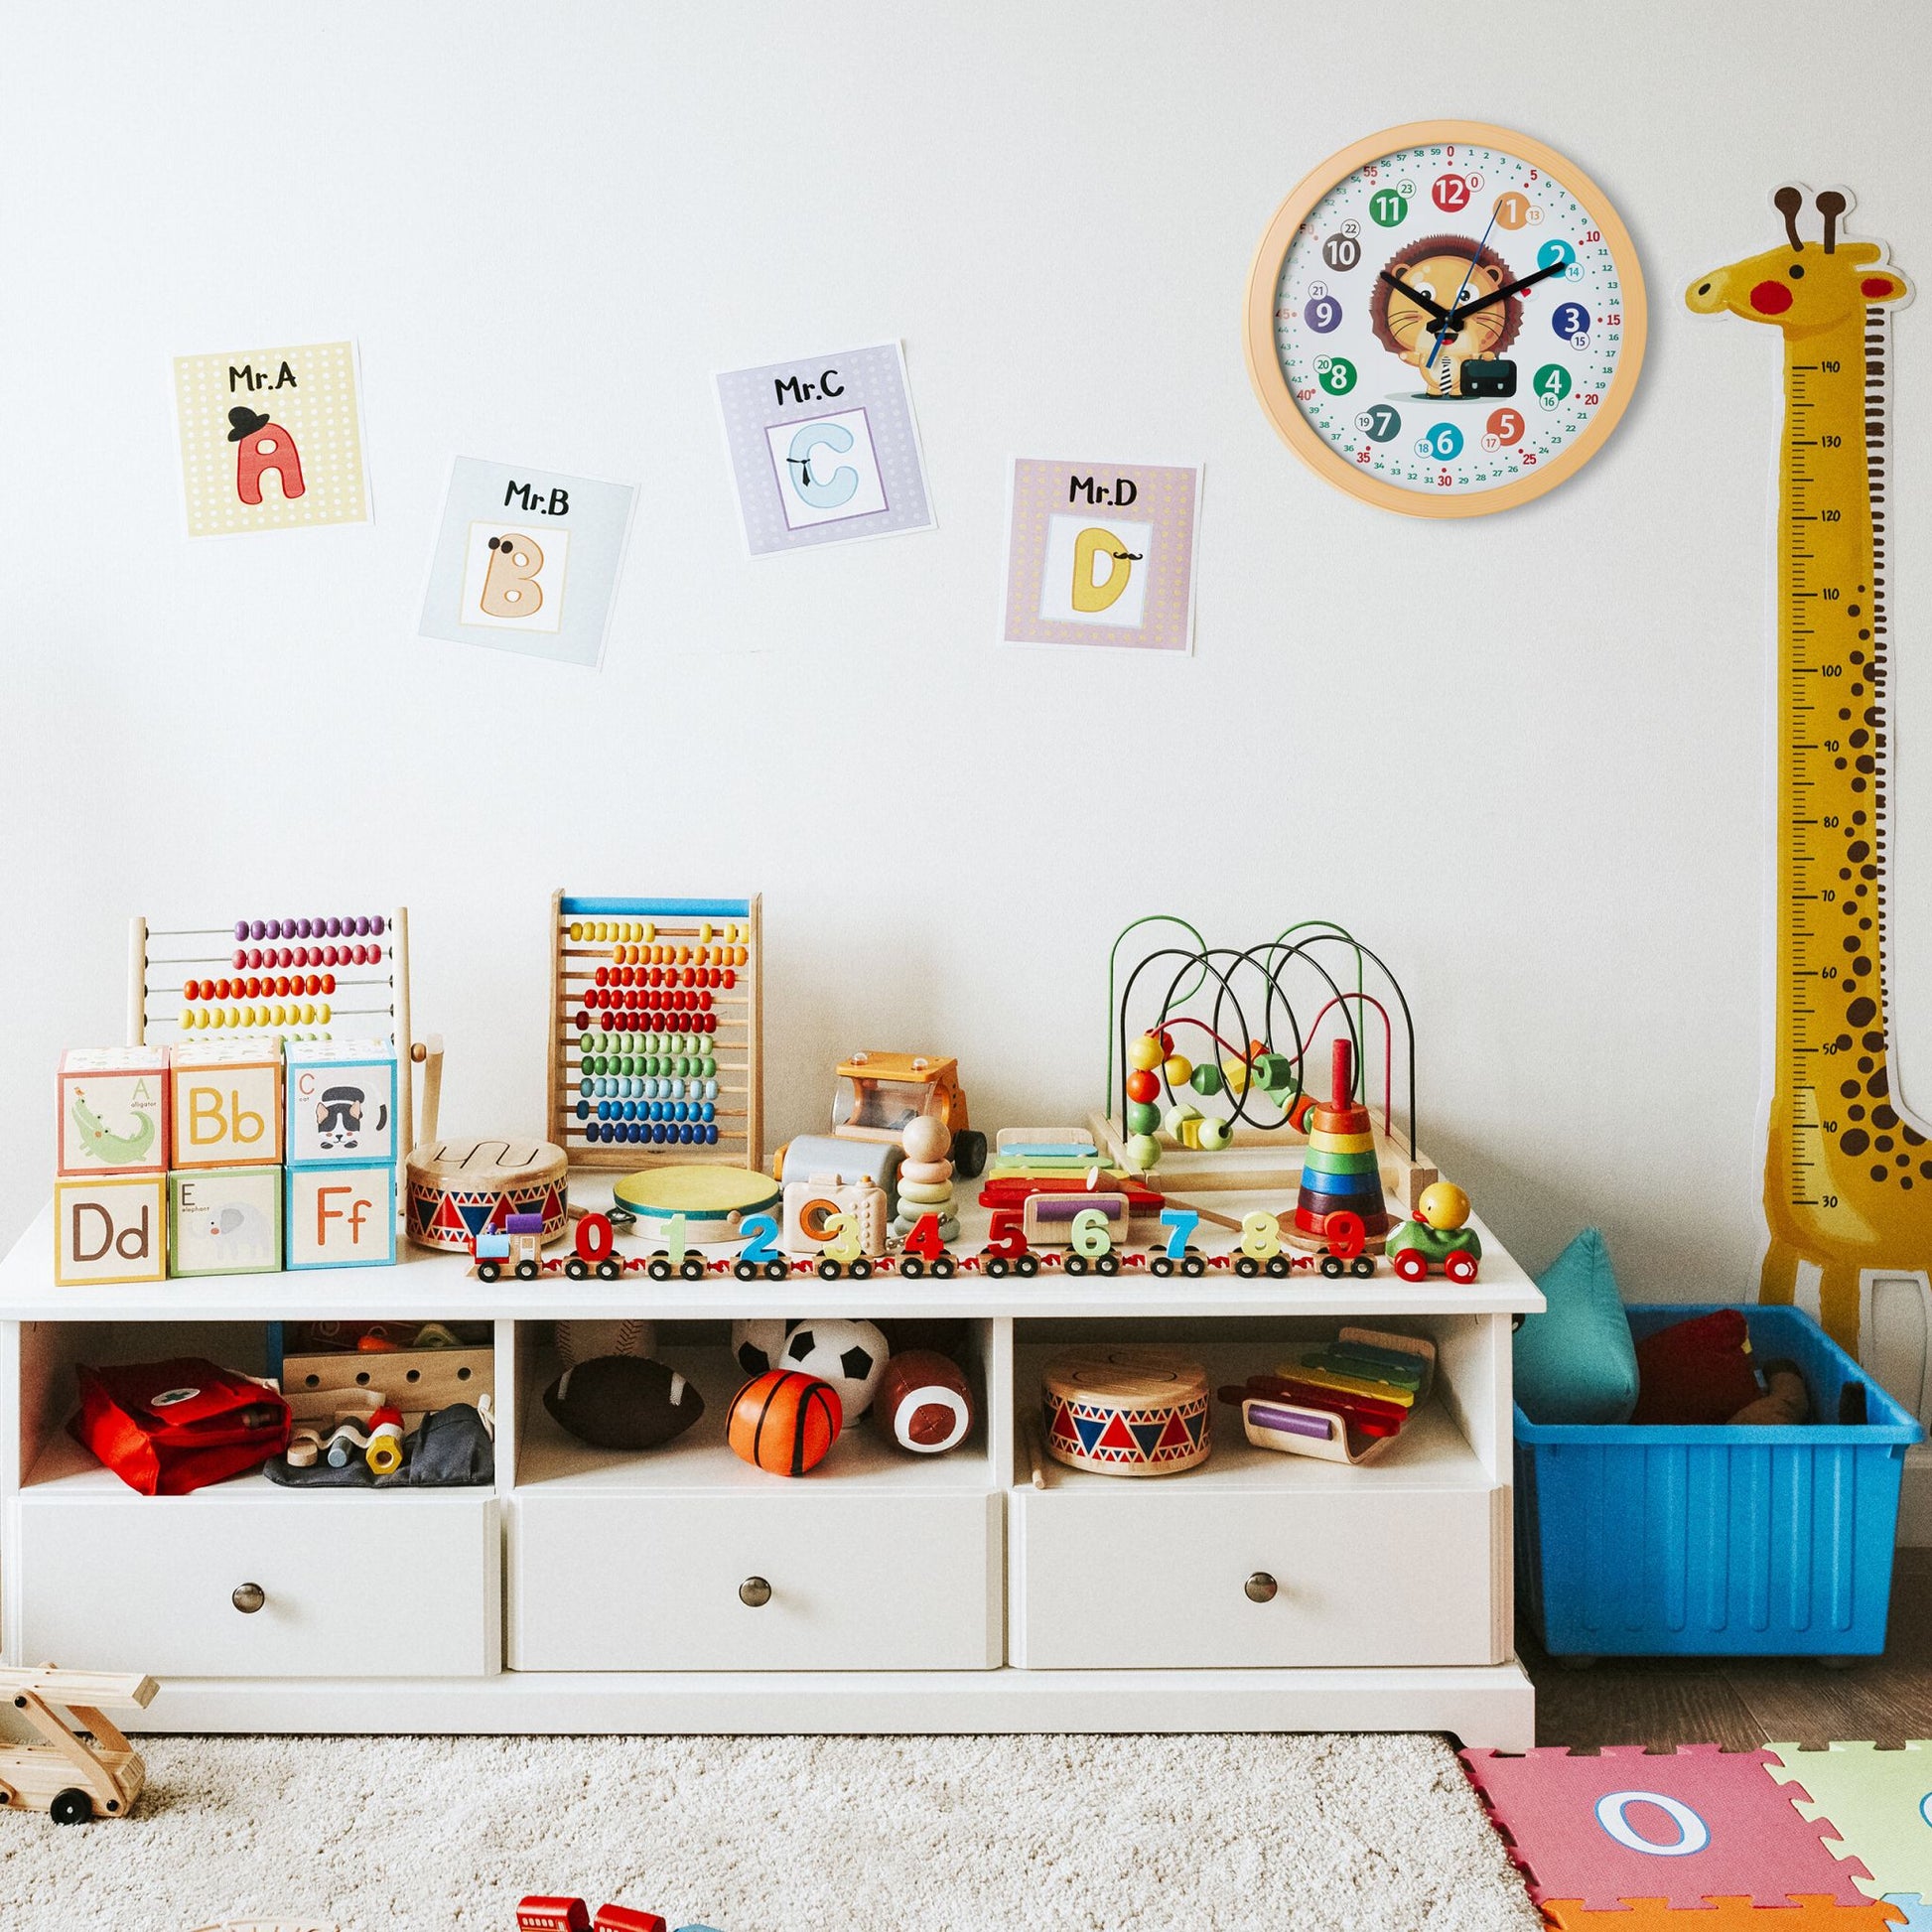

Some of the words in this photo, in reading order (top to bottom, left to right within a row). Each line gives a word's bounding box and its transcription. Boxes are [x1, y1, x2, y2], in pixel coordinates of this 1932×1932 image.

[1447, 146, 1454, 157] 0
[1363, 166, 1378, 177] 55
[1530, 170, 1538, 181] 5
[1401, 184, 1412, 194] 23
[1471, 177, 1478, 188] 0
[1436, 180, 1463, 204] 12
[1376, 197, 1399, 221] 11
[1506, 199, 1516, 223] 1
[1529, 210, 1540, 220] 13
[1345, 224, 1356, 234] 22
[1587, 231, 1600, 242] 10
[1327, 240, 1356, 265] 10
[1550, 245, 1565, 267] 2
[1569, 267, 1579, 277] 14
[1316, 302, 1332, 327] 9
[1565, 308, 1580, 333] 3
[1607, 315, 1620, 325] 15
[1575, 337, 1586, 345] 15
[1317, 360, 1329, 369] 20
[1821, 361, 1841, 374] 140
[228, 361, 298, 393] Mr.A
[1330, 364, 1347, 389] 8
[1545, 369, 1562, 394] 4
[774, 369, 845, 406] Mr.C
[1297, 389, 1311, 400] 40
[1544, 397, 1555, 406] 16
[1585, 394, 1598, 405] 20
[1359, 417, 1369, 427] 19
[1376, 412, 1392, 437] 7
[1500, 414, 1515, 439] 5
[1419, 444, 1429, 454] 18
[1438, 430, 1453, 455] 6
[1486, 438, 1496, 448] 17
[1821, 436, 1842, 449] 130
[788, 422, 859, 508] C
[1356, 453, 1371, 463] 35
[1523, 454, 1537, 465] 25
[1438, 476, 1451, 486] 30
[503, 480, 570, 516] Mr.B
[1069, 476, 1138, 506] Mr.D
[1820, 510, 1841, 523] 120
[480, 532, 544, 619] B
[1071, 527, 1132, 614] D
[1822, 588, 1840, 601] 110
[1821, 664, 1843, 677] 100
[1824, 740, 1840, 754] 90
[1823, 814, 1840, 829] 80
[1821, 889, 1836, 902] 70
[1821, 966, 1838, 979] 60
[1822, 1041, 1838, 1055] 50
[132, 1077, 150, 1100] A
[299, 1072, 315, 1095] C
[190, 1087, 265, 1146] Bb
[1822, 1119, 1838, 1133] 40
[182, 1183, 195, 1206] E
[1822, 1195, 1839, 1209] 30
[317, 1186, 372, 1246] Ff
[72, 1202, 148, 1262] Dd
[575, 1212, 615, 1263] 0
[659, 1213, 686, 1263] 1
[739, 1212, 780, 1262] 2
[823, 1212, 862, 1263] 3
[904, 1211, 944, 1261] 4
[988, 1210, 1028, 1258] 5
[1071, 1209, 1111, 1257] 6
[1160, 1210, 1200, 1259] 7
[1240, 1210, 1281, 1258] 8
[1324, 1210, 1366, 1258] 9
